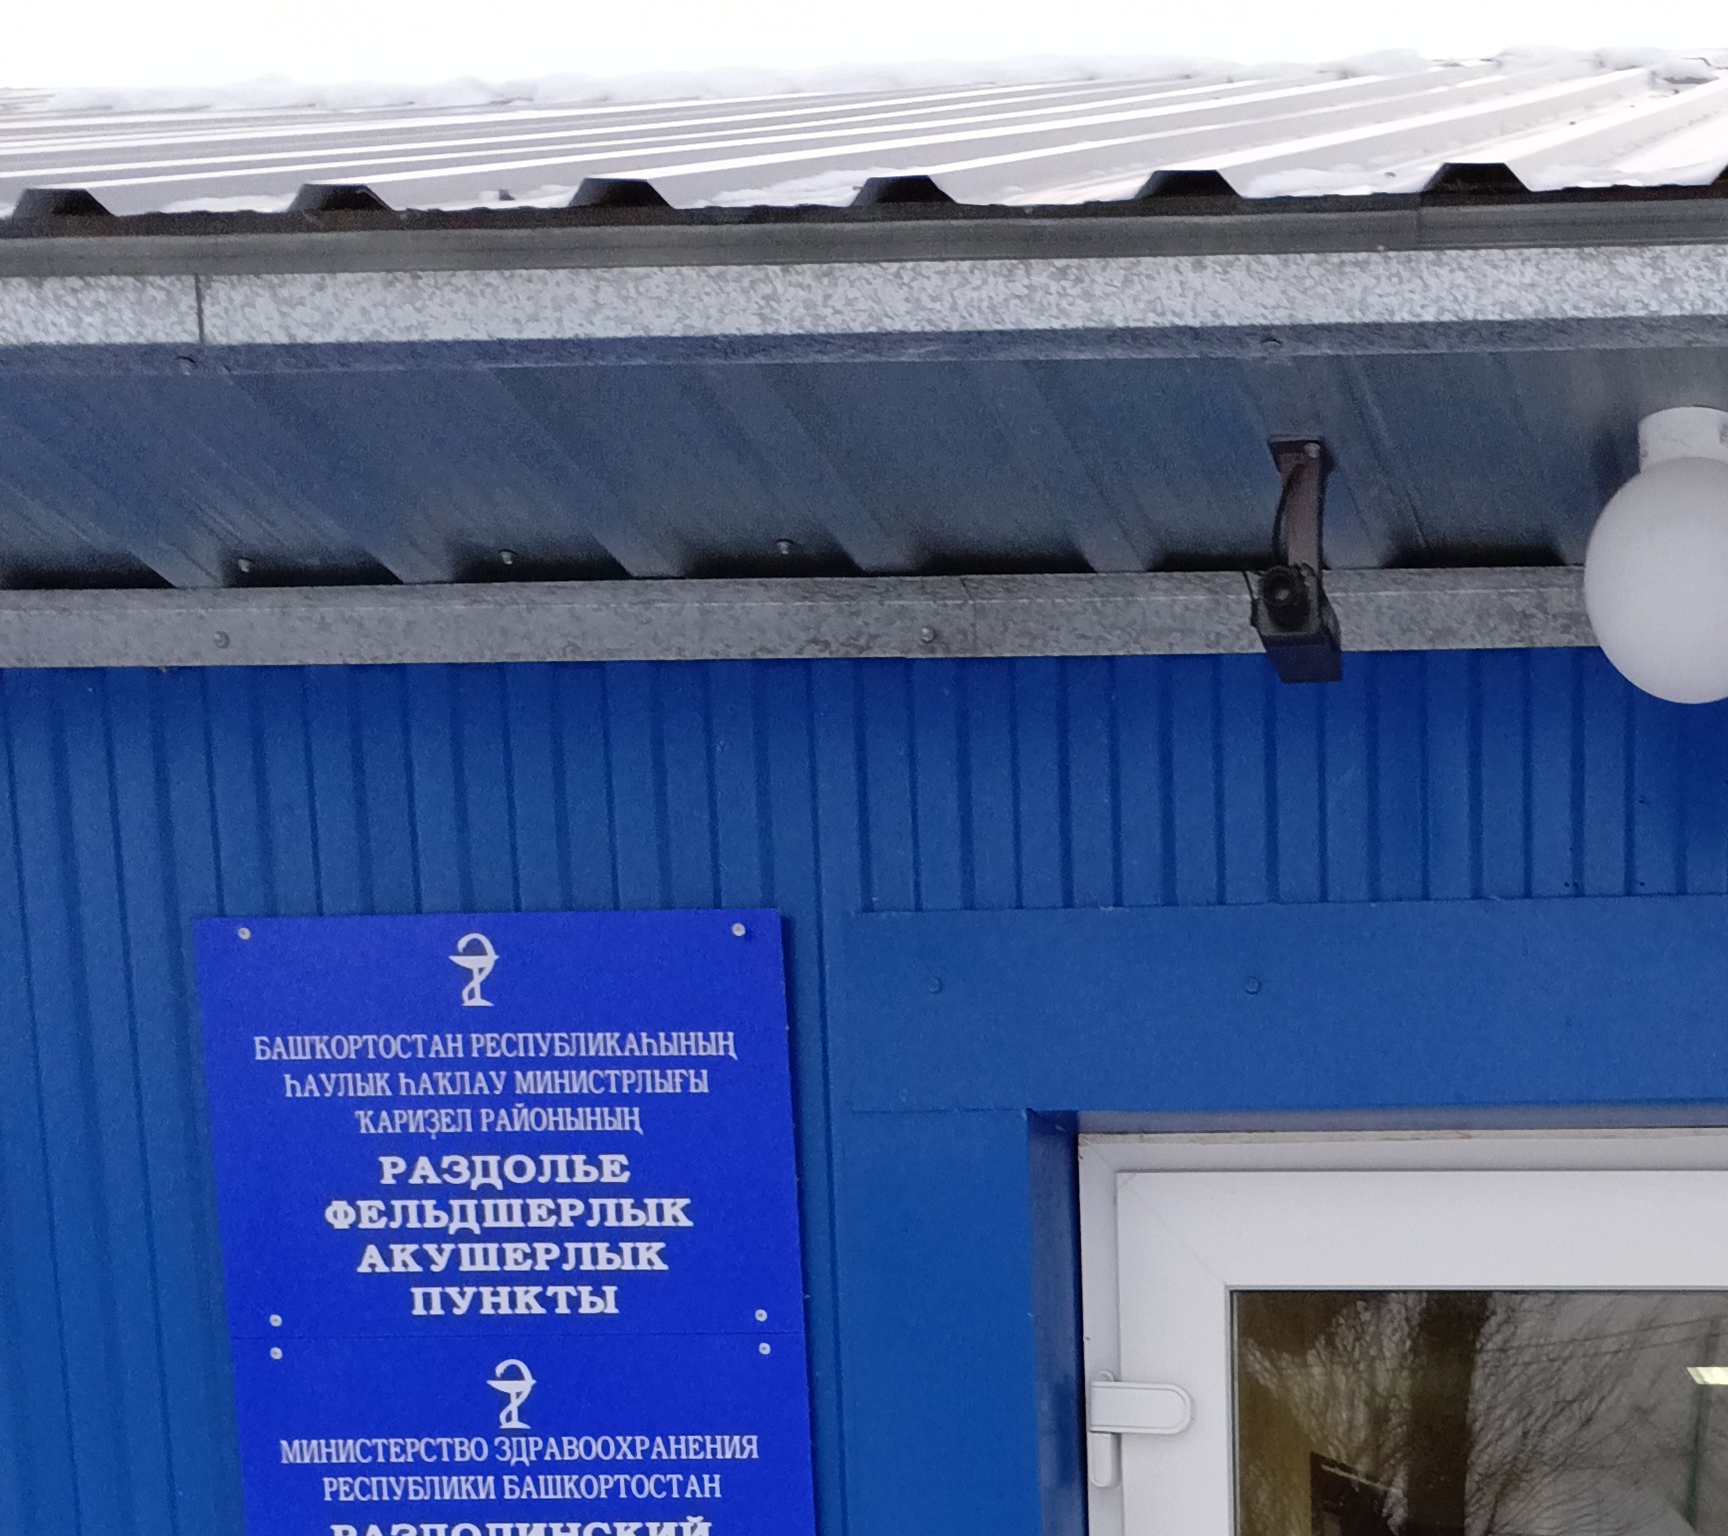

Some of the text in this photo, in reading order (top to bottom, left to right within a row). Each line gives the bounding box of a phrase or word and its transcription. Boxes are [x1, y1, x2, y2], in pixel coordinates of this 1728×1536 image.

[480, 1102, 644, 1135] РАЙОНЫНЫҢ
[378, 1154, 631, 1191] РАЗДОЛЬЕ
[324, 1198, 694, 1235] ФЕЛЬДШЕРЛЫК
[356, 1241, 669, 1273] АКУШЕРЛЫК
[410, 1285, 619, 1316] ПУНКТЫ
[280, 1435, 759, 1467] МИНИСТЕРСТВО ЗДРАВООХРАНЕНИЯ
[323, 1474, 722, 1501] РЕСПУБЛИКИ БАШКОРТОСТАН
